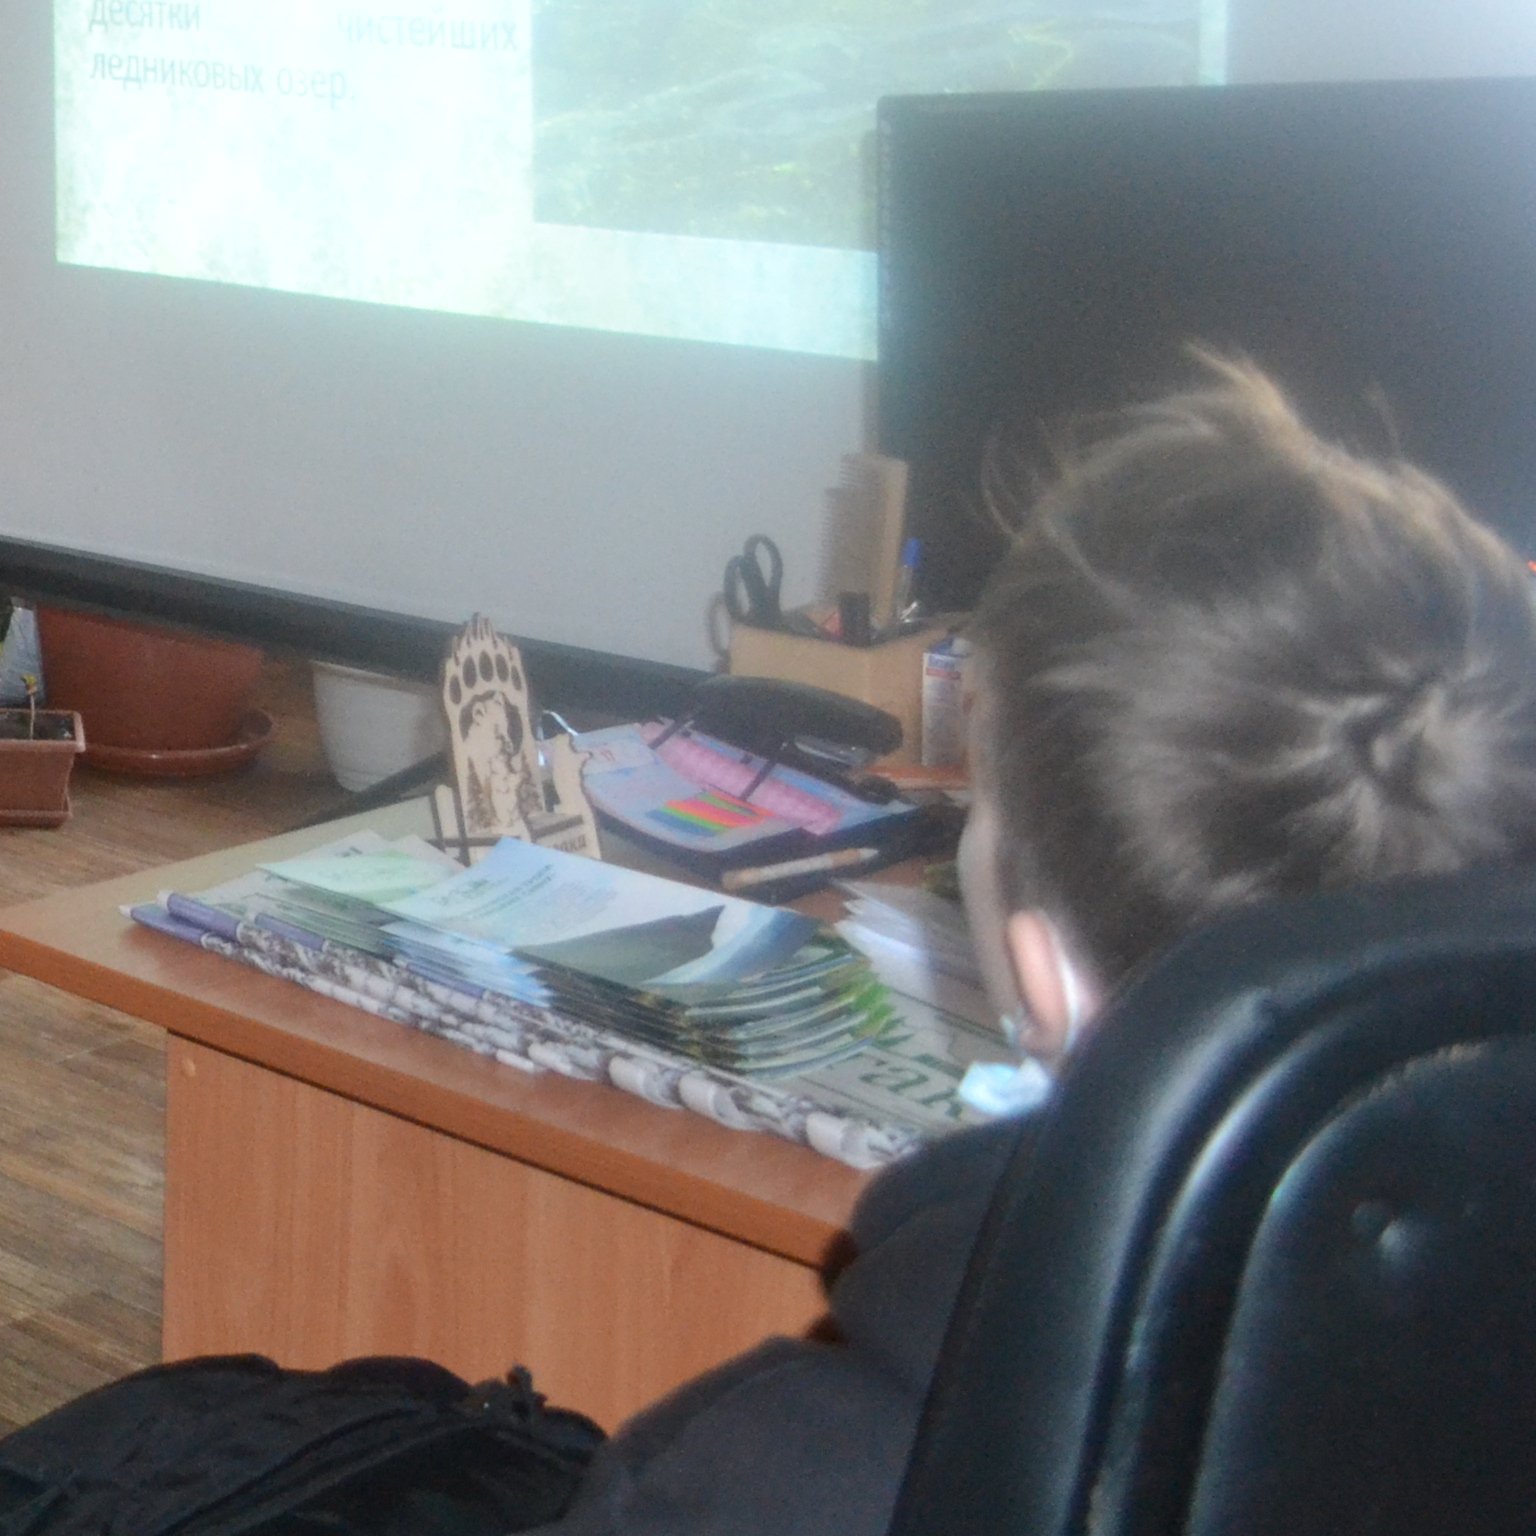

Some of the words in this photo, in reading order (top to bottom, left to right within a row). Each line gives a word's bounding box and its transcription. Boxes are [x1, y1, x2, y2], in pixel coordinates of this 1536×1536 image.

[337, 4, 517, 52] чистейших
[91, 50, 265, 94] ледниковых
[277, 66, 357, 107] озер.
